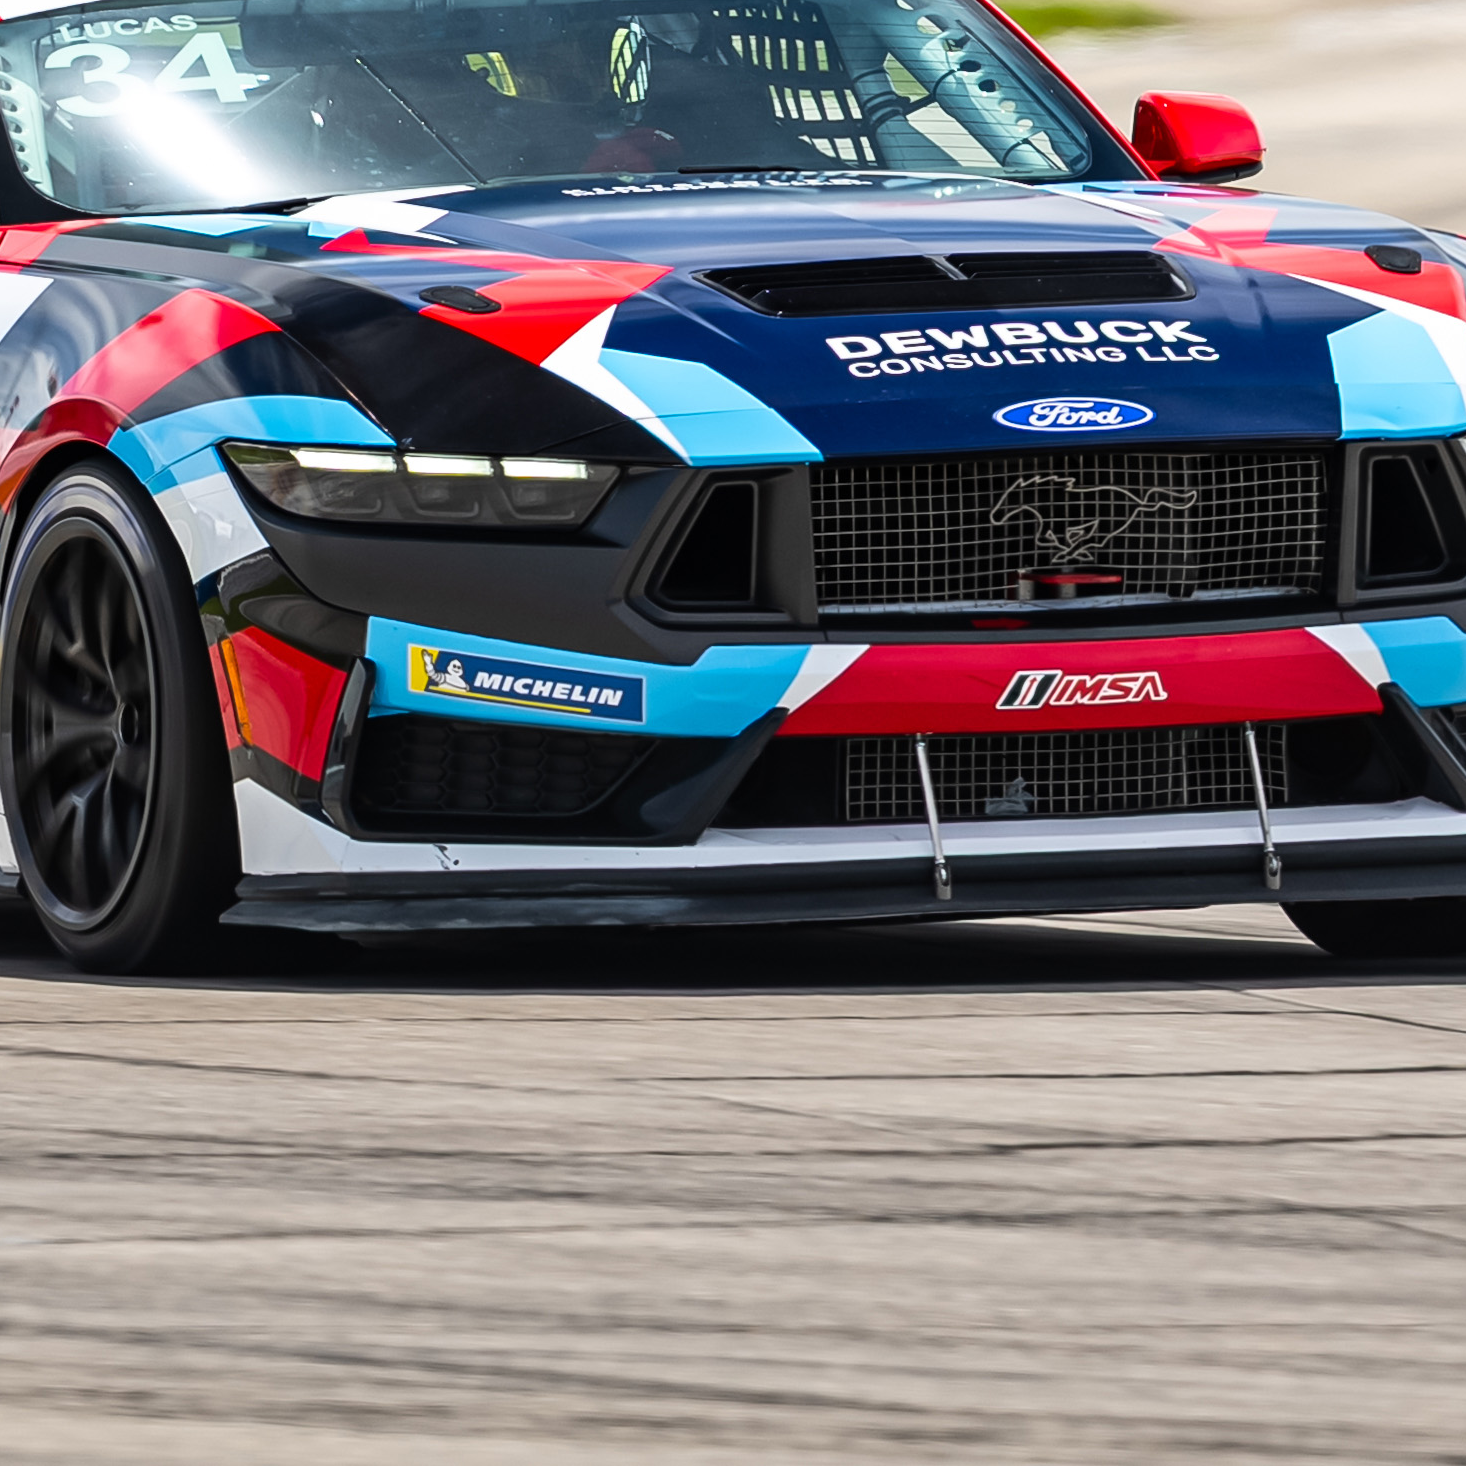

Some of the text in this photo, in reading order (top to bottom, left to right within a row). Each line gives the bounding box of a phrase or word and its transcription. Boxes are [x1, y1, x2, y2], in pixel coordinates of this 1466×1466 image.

[56, 14, 197, 42] LUCAS
[44, 32, 260, 117] 34
[825, 320, 1208, 360] DEWBUCK
[847, 345, 1221, 378] CONSULTING LLC
[1028, 402, 1123, 427] Ford
[473, 671, 624, 707] MICHELIN
[1049, 671, 1168, 705] IMSA
